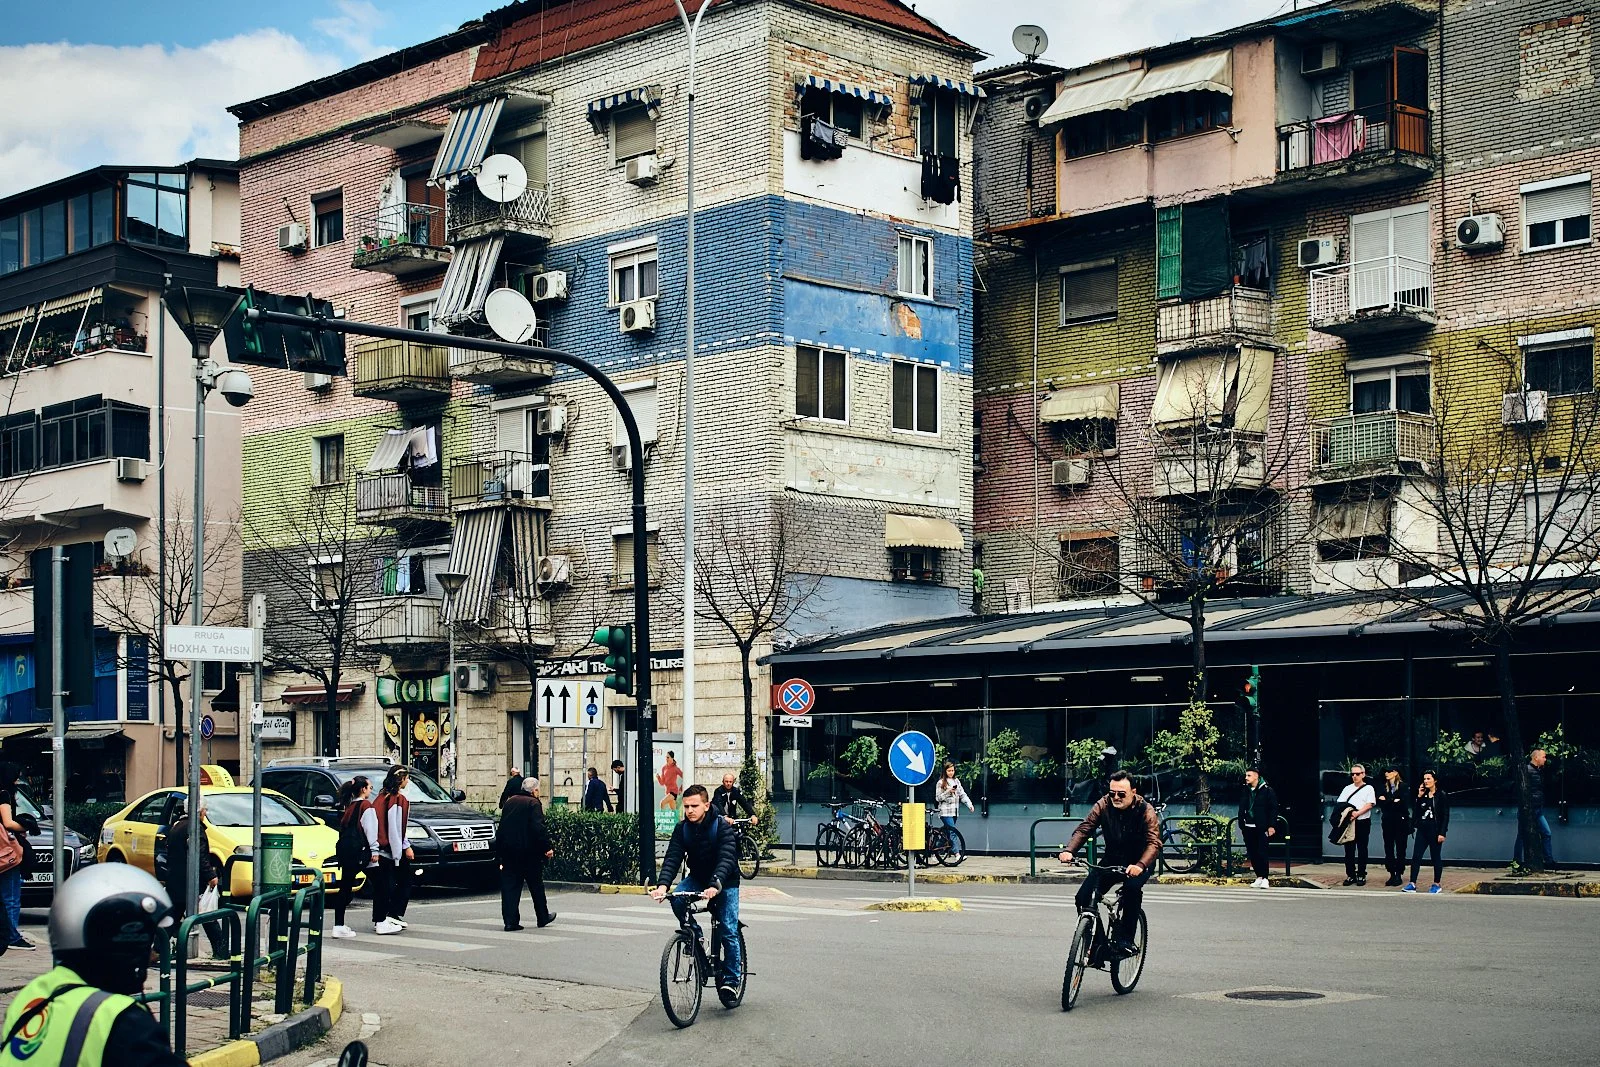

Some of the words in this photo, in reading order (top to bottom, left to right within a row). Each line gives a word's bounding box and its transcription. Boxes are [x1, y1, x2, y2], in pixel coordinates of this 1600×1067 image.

[194, 631, 225, 641] RRUGA
[169, 643, 208, 654] HOXHA
[212, 644, 250, 655] TAHSIN
